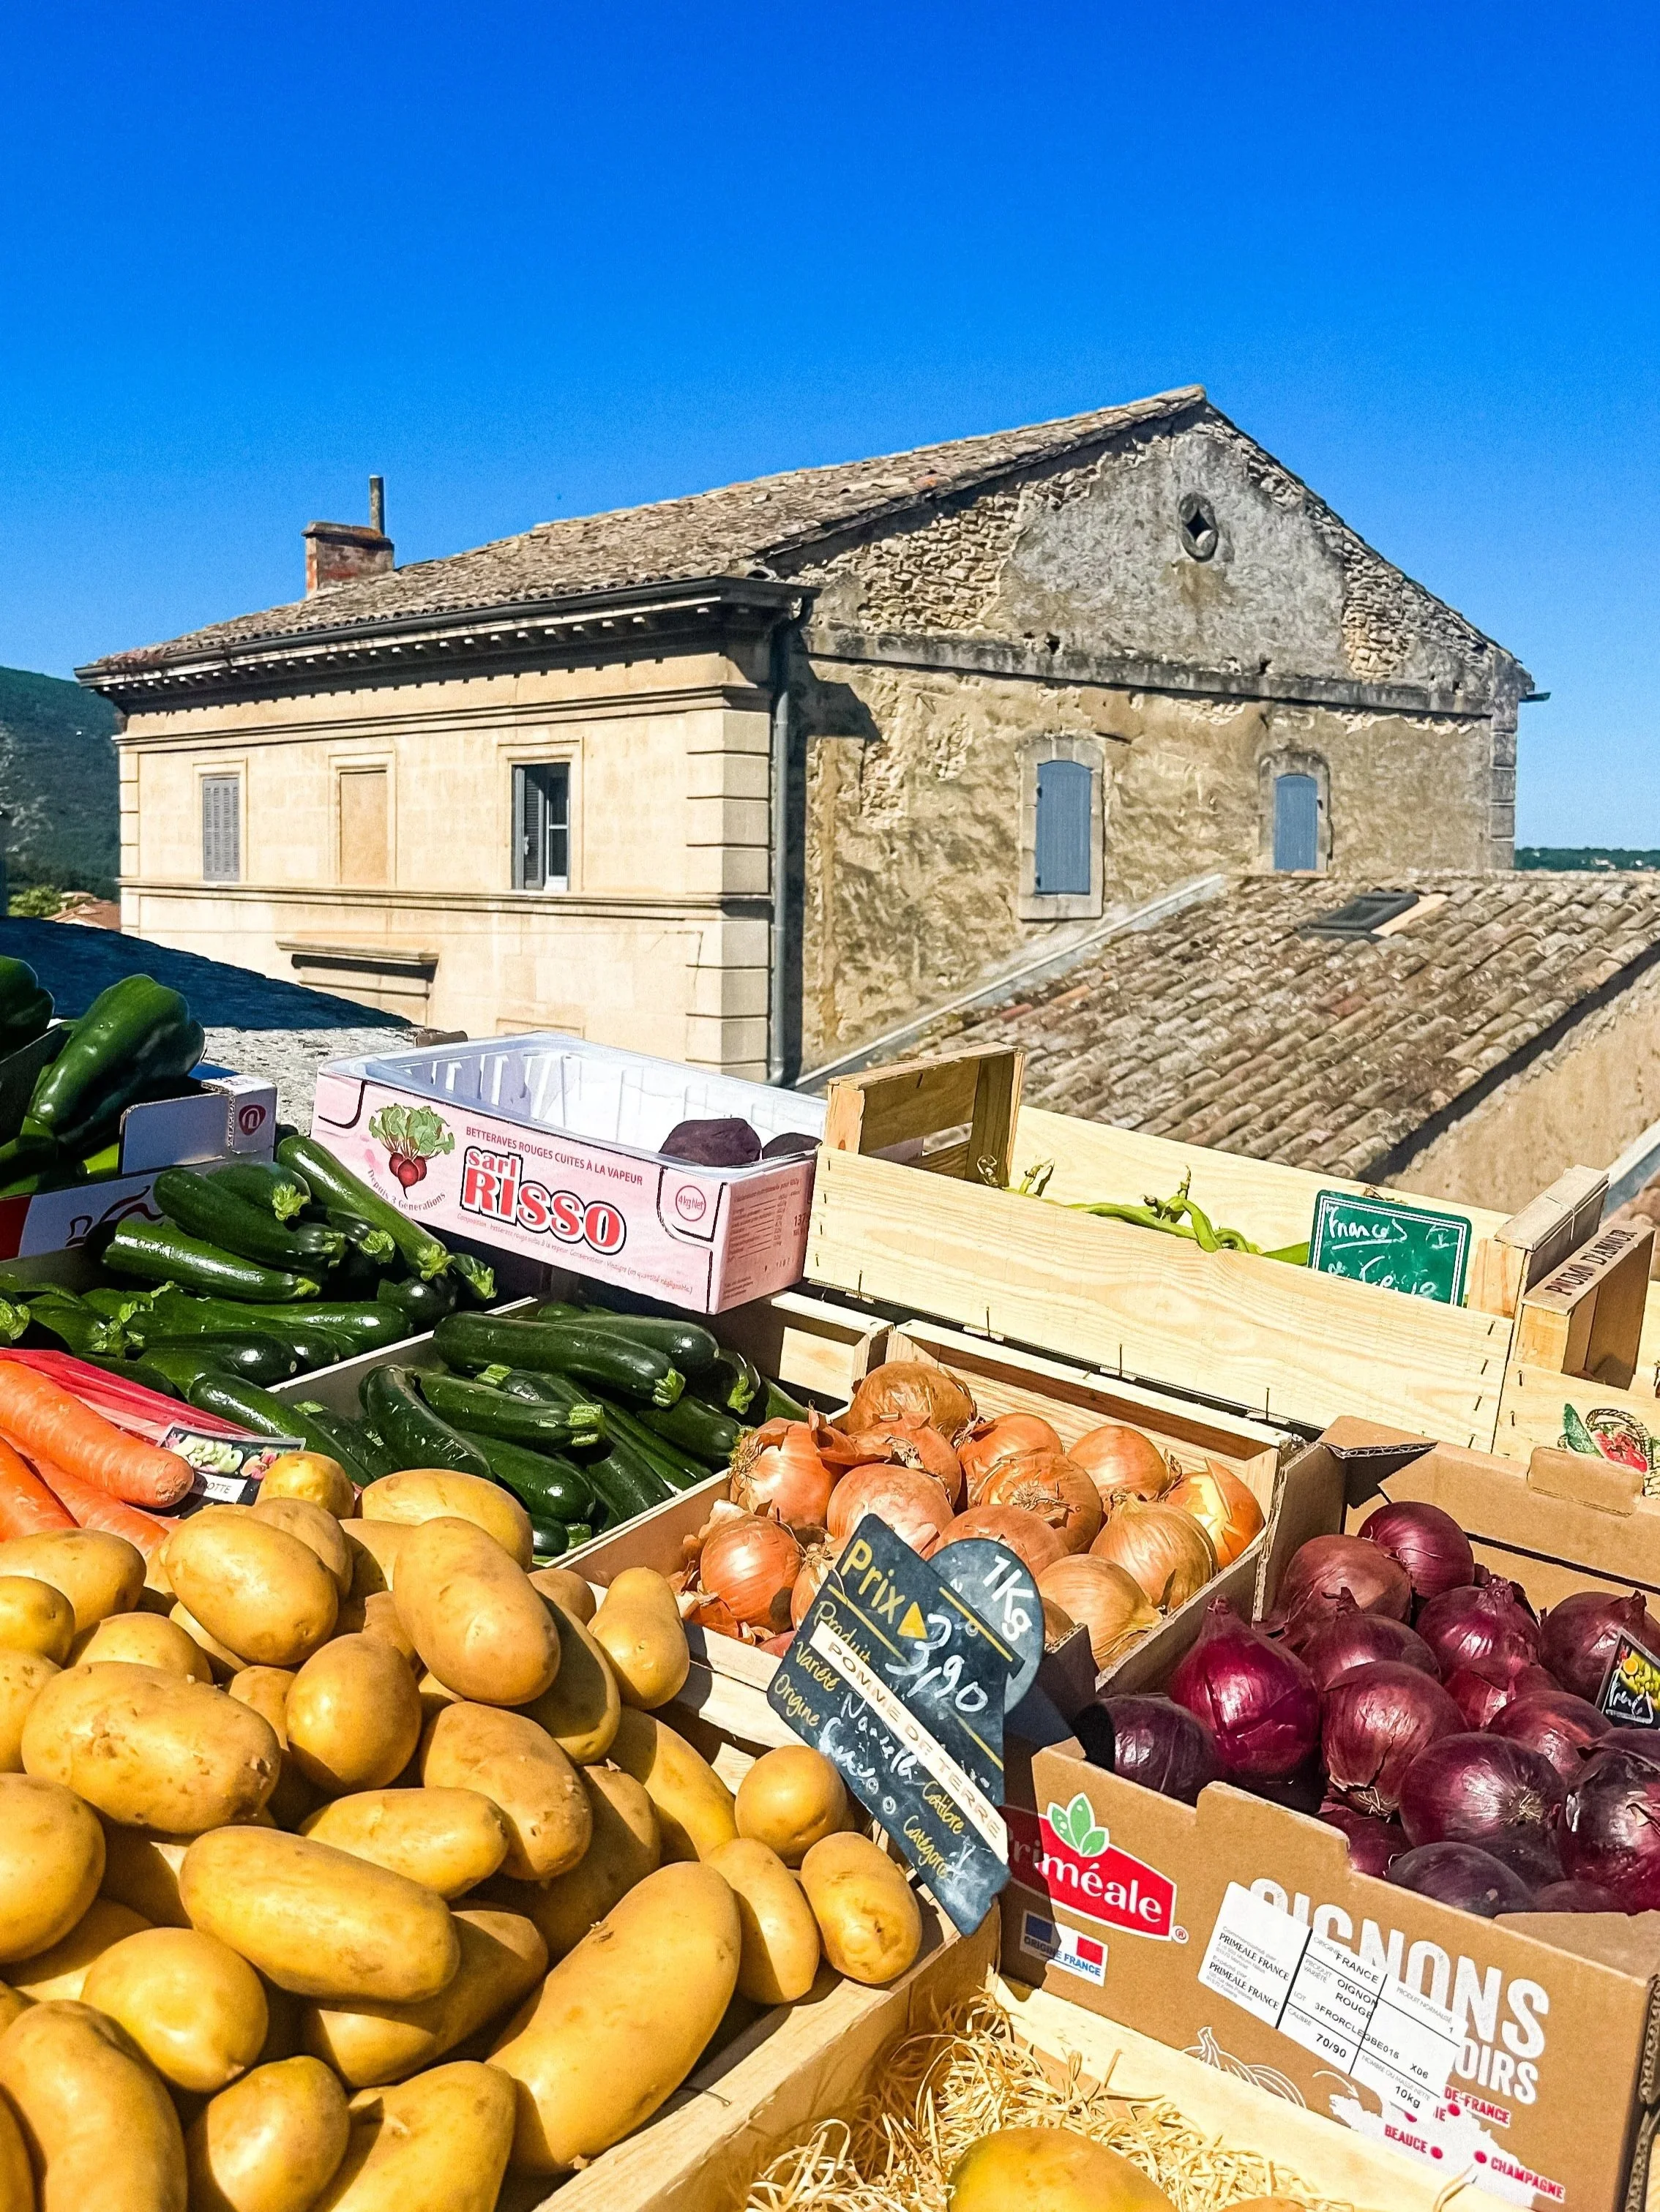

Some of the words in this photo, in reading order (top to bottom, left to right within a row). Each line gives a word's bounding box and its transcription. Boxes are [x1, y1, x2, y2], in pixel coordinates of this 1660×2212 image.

[466, 1126, 517, 1149] BETTERAVES
[518, 1141, 553, 1159] ROUGES
[555, 1152, 584, 1169] CUITES
[595, 1163, 605, 1175] LA
[607, 1167, 643, 1185] VAPEUR
[468, 1151, 516, 1177] sarl
[367, 1169, 389, 1199] Depuis
[463, 1166, 622, 1248] RISSO
[841, 1538, 905, 1624] Prix
[774, 1673, 820, 1727] Origine
[829, 1641, 902, 1722] POMME
[905, 1725, 932, 1756] DE
[938, 1757, 1001, 1839] TERRE
[1009, 1829, 1162, 1923] riméale
[1063, 1952, 1102, 1977] FRANCE
[1219, 1932, 1257, 1961] PRIMEALE
[1258, 1957, 1290, 1982] FRANCE
[1336, 1953, 1379, 1984] FRANCE
[1209, 1962, 1247, 1990] PRIMEALE
[1248, 1985, 1279, 2011] FRANCE
[1335, 1992, 1373, 2020] ROUGE
[1337, 1979, 1377, 2009] OIGNON
[1316, 2033, 1347, 2058] 70/90
[1454, 2037, 1538, 2105] OIRS
[1396, 2086, 1421, 2110] 10kg
[1385, 2124, 1428, 2154] BEAUCE
[1491, 2156, 1565, 2199] CHAMPAGNE
